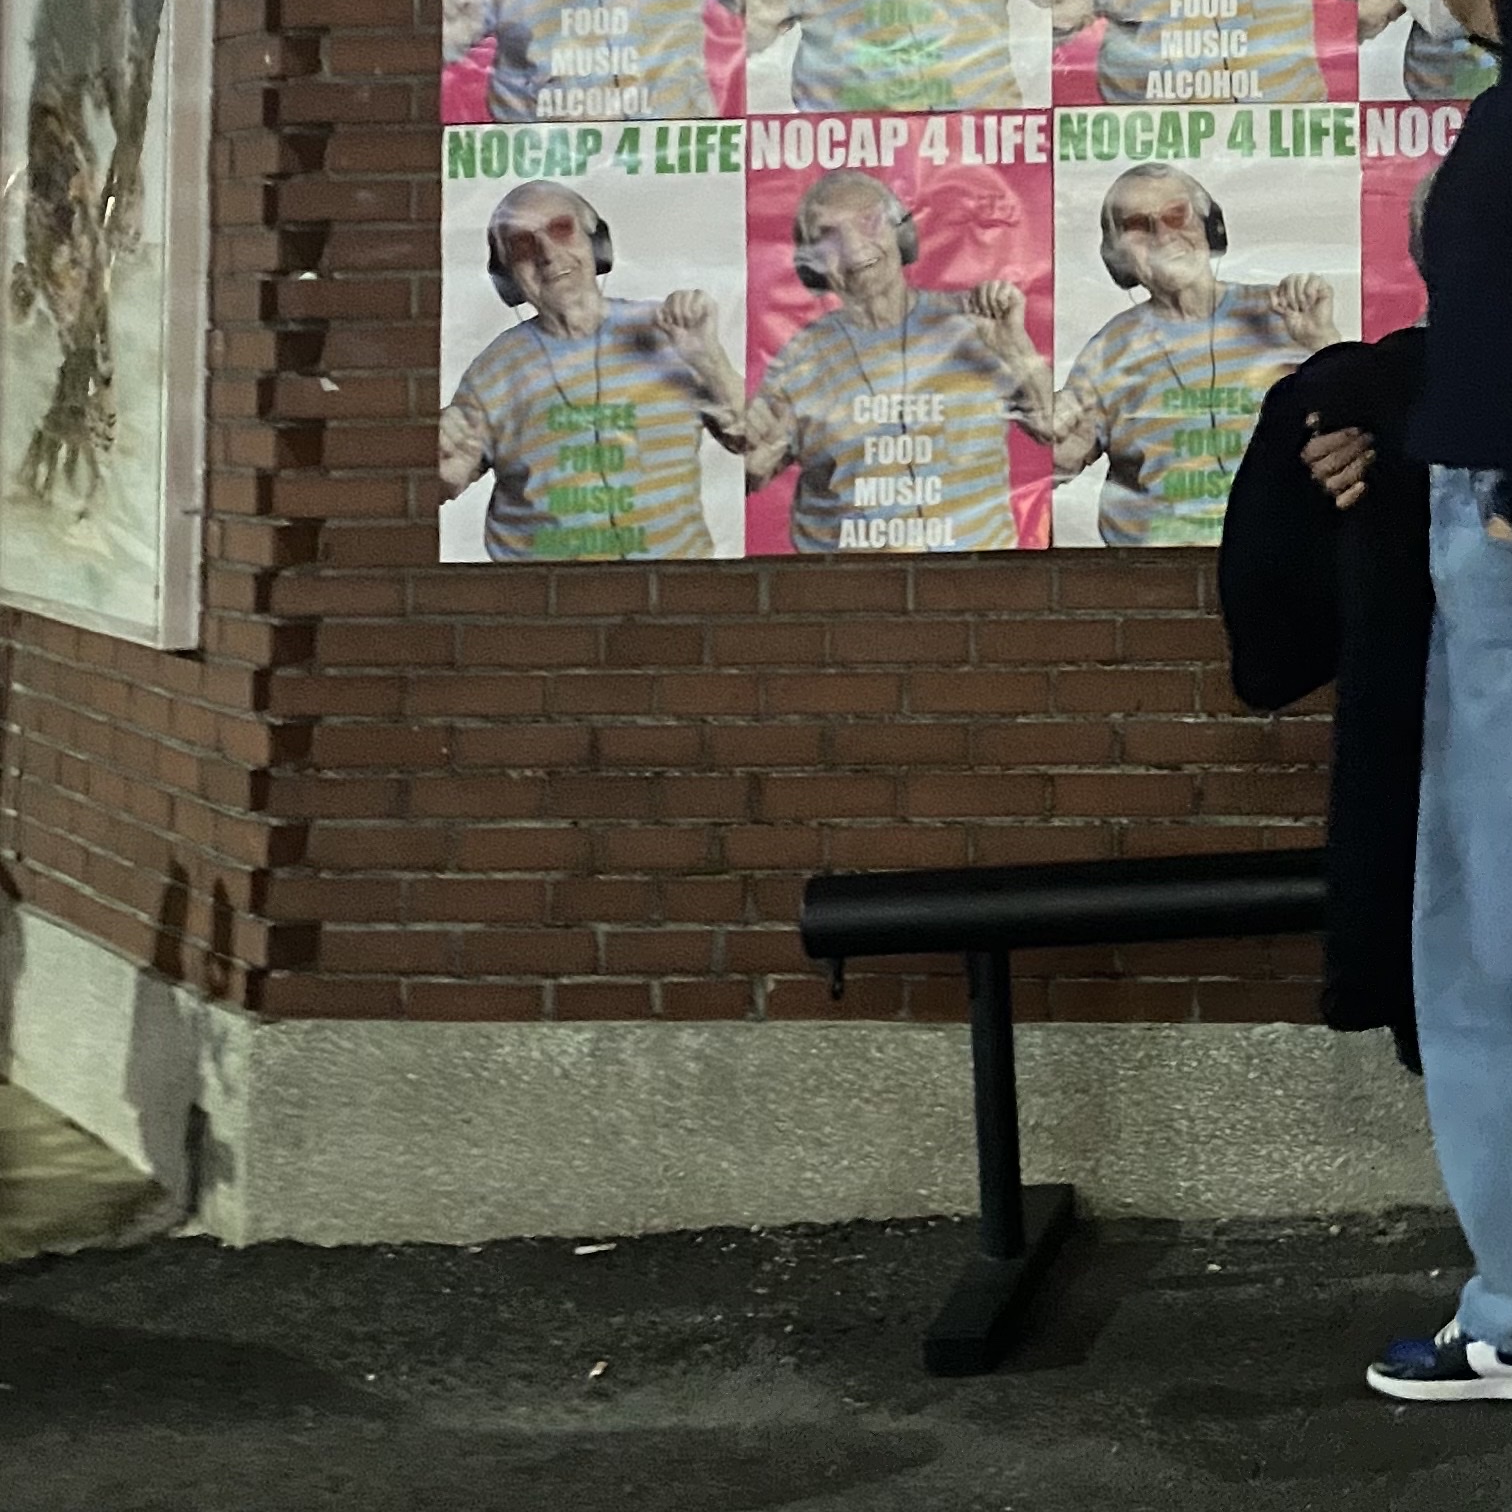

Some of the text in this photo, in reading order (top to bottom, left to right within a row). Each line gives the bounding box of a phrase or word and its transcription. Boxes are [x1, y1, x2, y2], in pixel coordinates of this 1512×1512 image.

[561, 7, 629, 37] FOOD
[1161, 29, 1247, 58] MUSIC
[551, 48, 639, 78] MUSIC
[1146, 69, 1262, 99] ALCOHOL
[536, 87, 651, 117] ALCOHOL
[751, 115, 1047, 170] NOCAP 4 LIFE
[1059, 108, 1356, 162] NOCAP 4 LIFE
[1367, 106, 1462, 158] NOC
[448, 125, 742, 178] NOCAP 4 LIFE
[854, 395, 944, 424] COFFEE
[865, 436, 932, 466] FOOD
[854, 476, 942, 507] MUSIC
[1162, 470, 1232, 503] MUS
[839, 518, 955, 549] ALCOHOL
